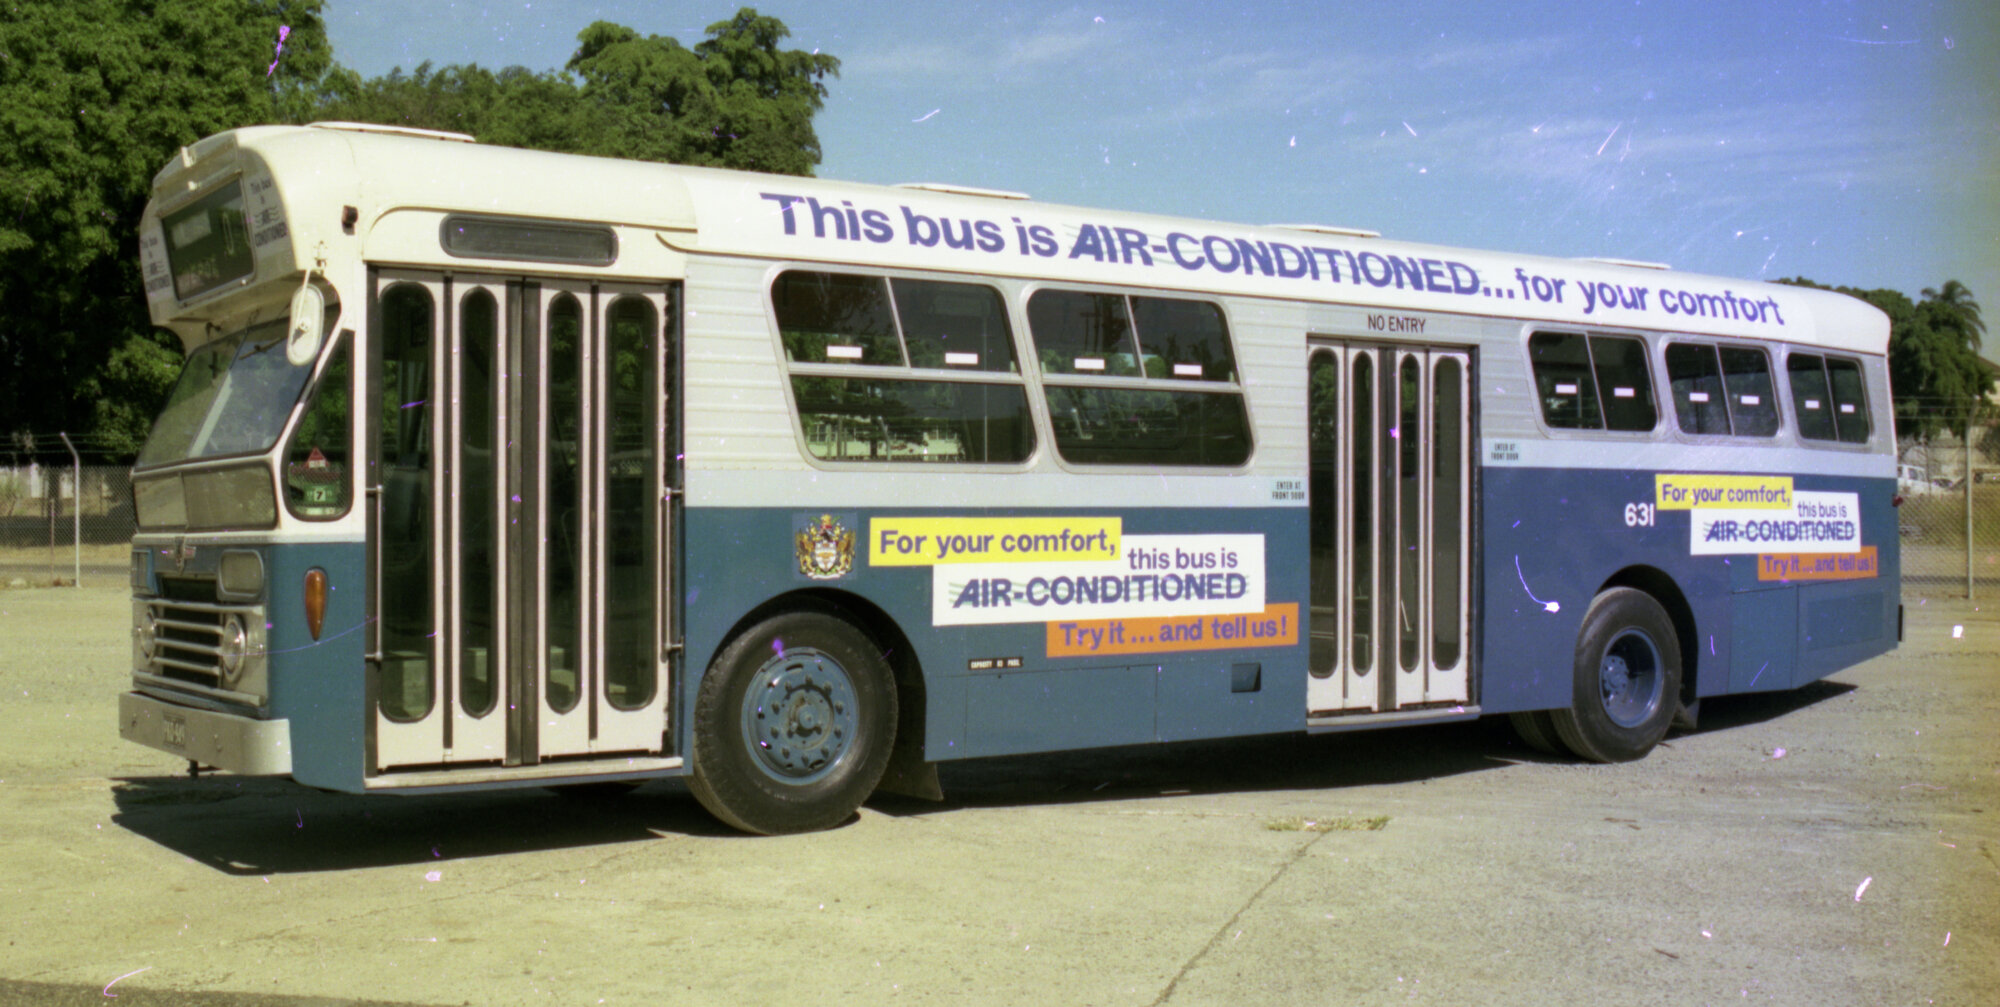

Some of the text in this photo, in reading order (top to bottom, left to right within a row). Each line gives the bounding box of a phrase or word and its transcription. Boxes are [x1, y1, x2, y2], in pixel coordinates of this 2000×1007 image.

[759, 192, 894, 243] This
[900, 205, 1005, 253] bus
[1011, 216, 1060, 258] is
[1577, 280, 1648, 314] your
[1659, 288, 1785, 326] comfort
[1368, 314, 1426, 333] NO ENTRY
[316, 491, 323, 500] 7
[1662, 484, 1791, 507] For your comfort,
[1625, 503, 1655, 527] 631
[1798, 501, 1848, 518] this bus is
[1705, 520, 1854, 542] AIR-CONDITIONED
[880, 528, 1115, 559] For your comfort,
[1128, 547, 1238, 569] this bus is
[1763, 555, 1793, 577] Try
[1791, 554, 1800, 572] it
[1815, 555, 1835, 572] and
[1838, 554, 1856, 572] tell
[953, 573, 1247, 608] AIR-CONDITIONED
[1059, 623, 1104, 650] Try
[1109, 622, 1125, 645] it
[1159, 618, 1203, 642] and
[1211, 616, 1247, 639] tell
